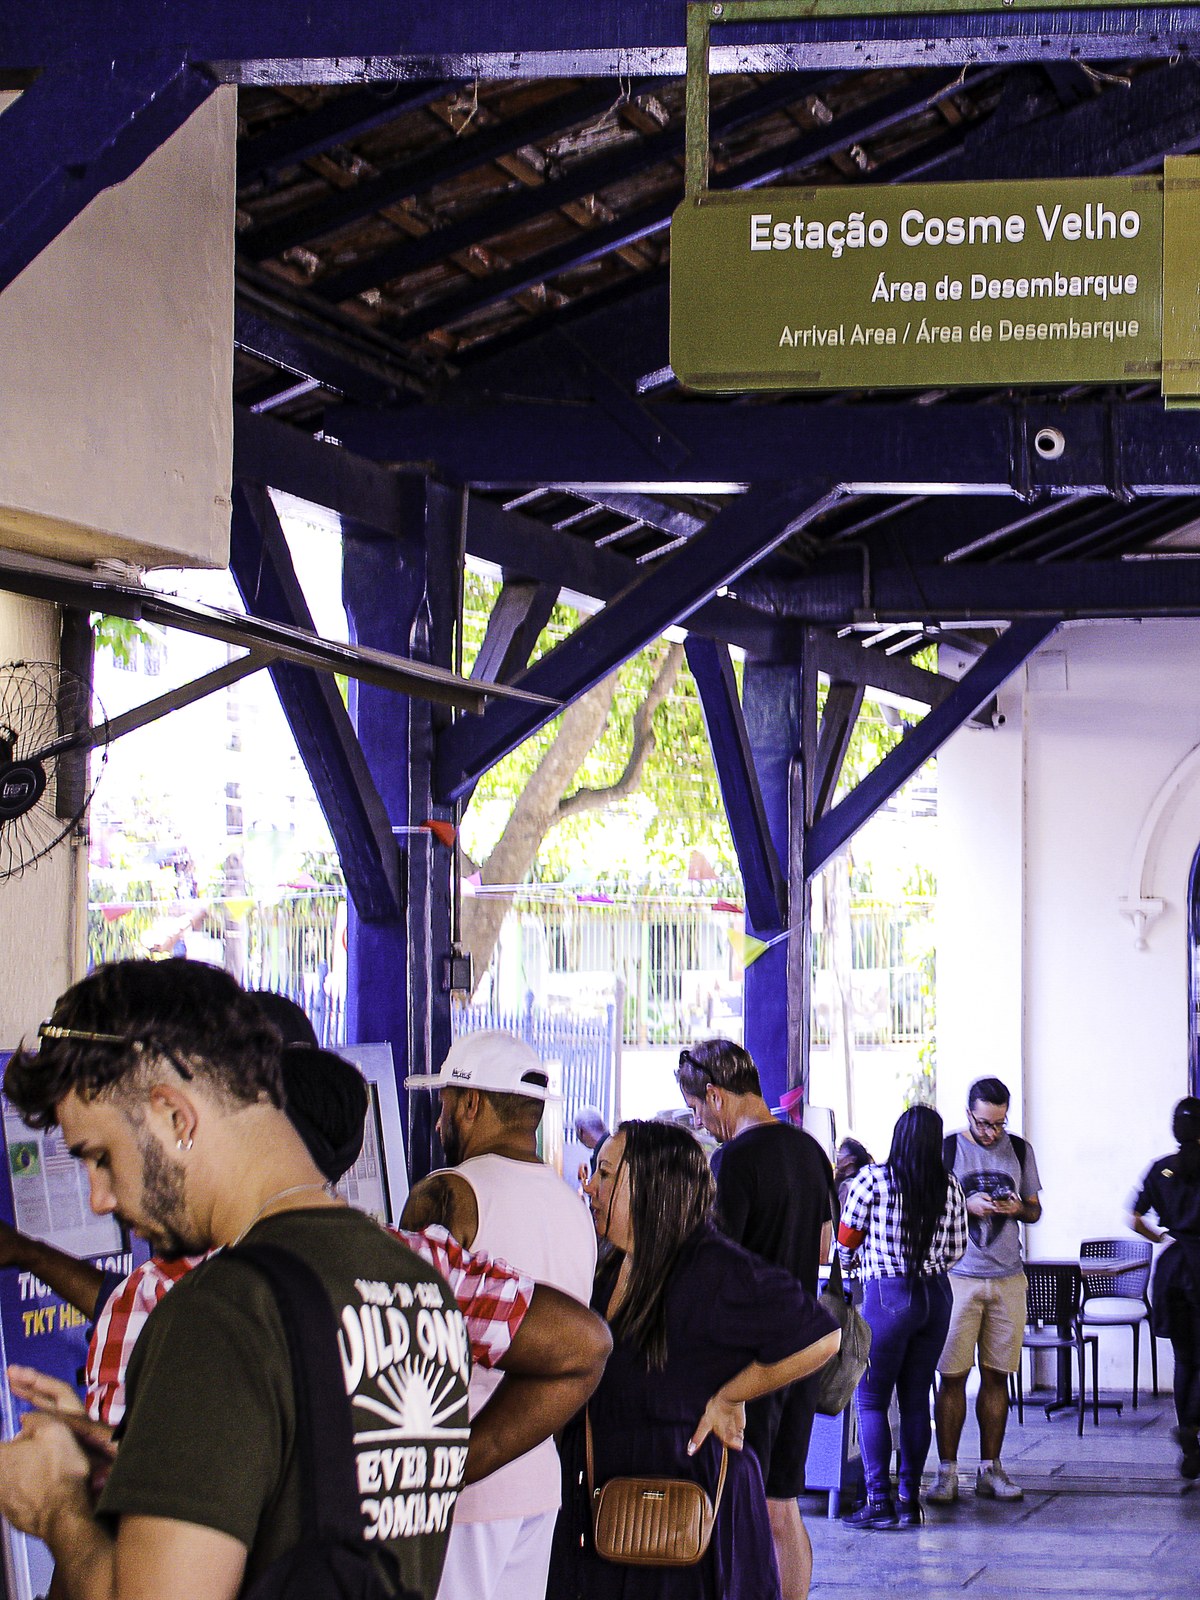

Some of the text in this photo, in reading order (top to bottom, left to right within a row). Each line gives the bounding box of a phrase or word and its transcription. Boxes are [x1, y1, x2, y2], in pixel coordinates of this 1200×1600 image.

[751, 202, 1141, 258] Estação Cosme Velho
[871, 271, 1138, 302] Área de Desembarque
[779, 324, 845, 347] Arrival
[850, 324, 896, 345] Area
[916, 318, 962, 343] Área
[969, 321, 993, 342] de
[999, 318, 1139, 342] Desembarque
[22, 1305, 57, 1338] TKT
